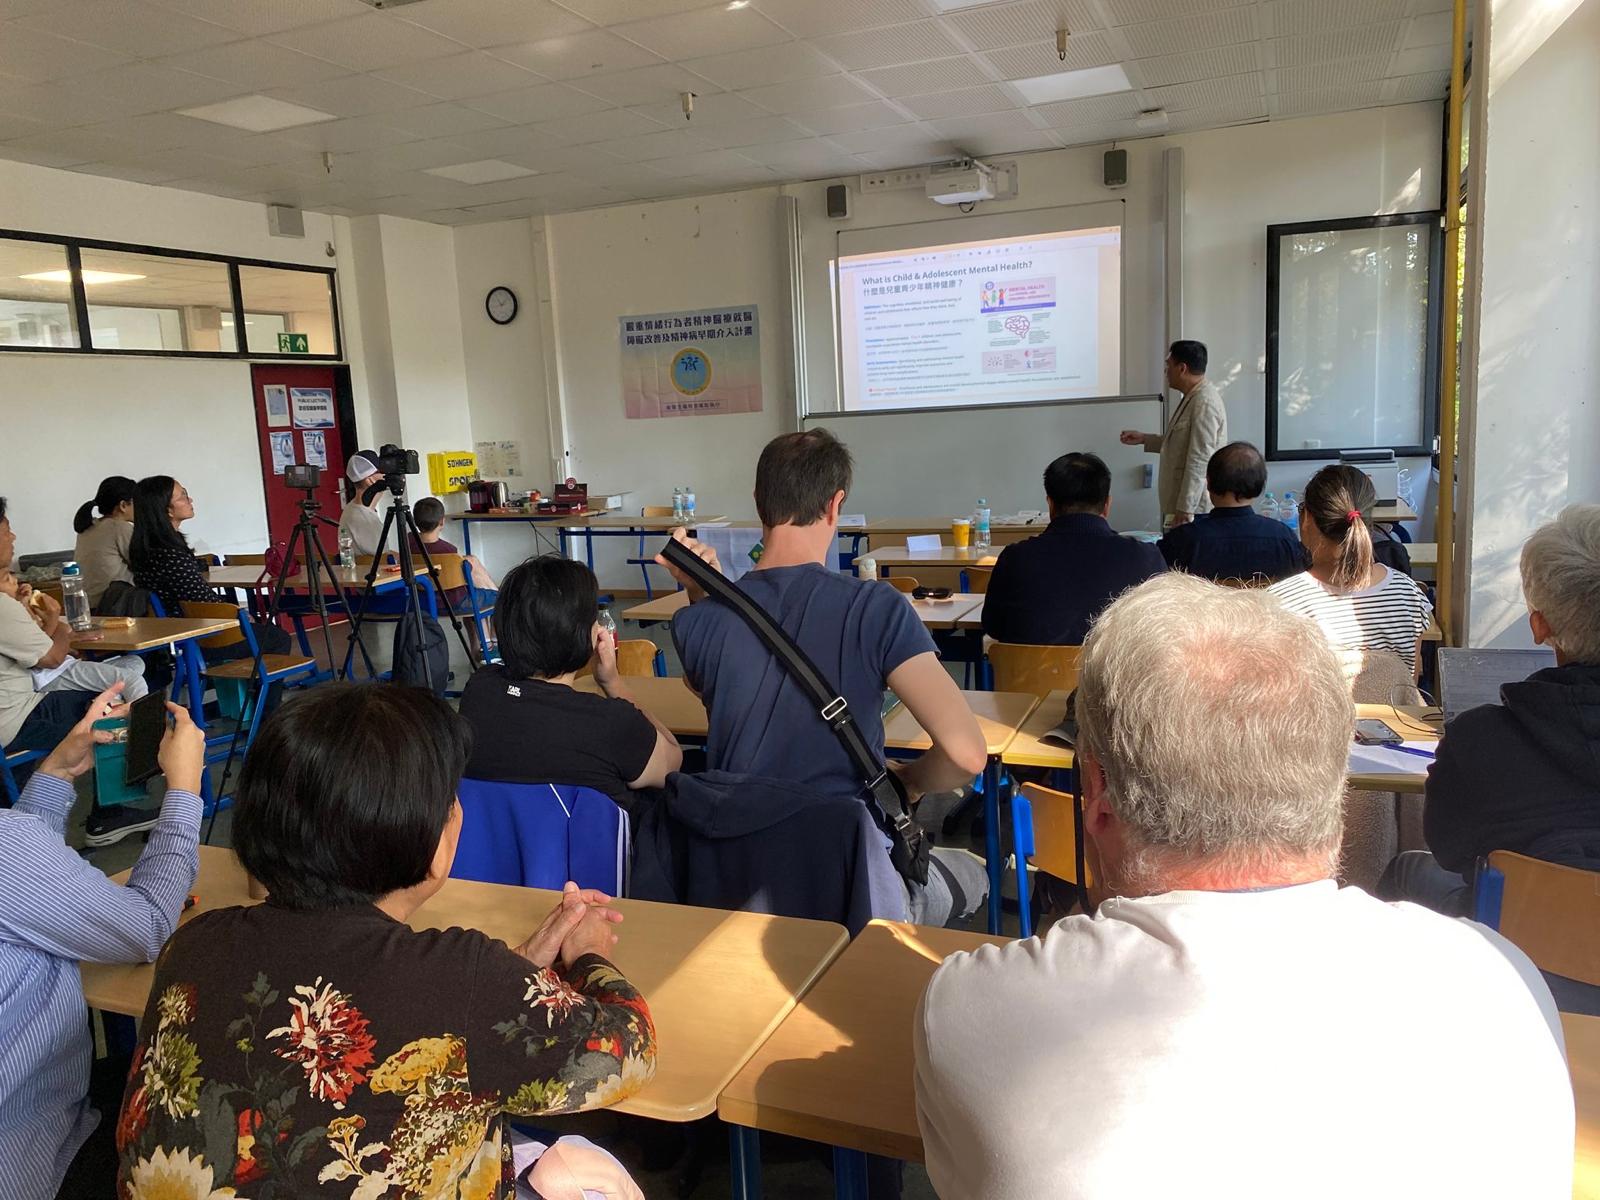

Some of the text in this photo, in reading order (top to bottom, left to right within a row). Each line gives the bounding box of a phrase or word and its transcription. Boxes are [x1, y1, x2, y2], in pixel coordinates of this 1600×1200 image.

[862, 276, 883, 286] What
[892, 273, 913, 283] Child
[914, 272, 921, 280] &
[922, 268, 967, 279] Adolescent
[968, 264, 998, 275] Mental
[1000, 260, 1033, 272] Health?
